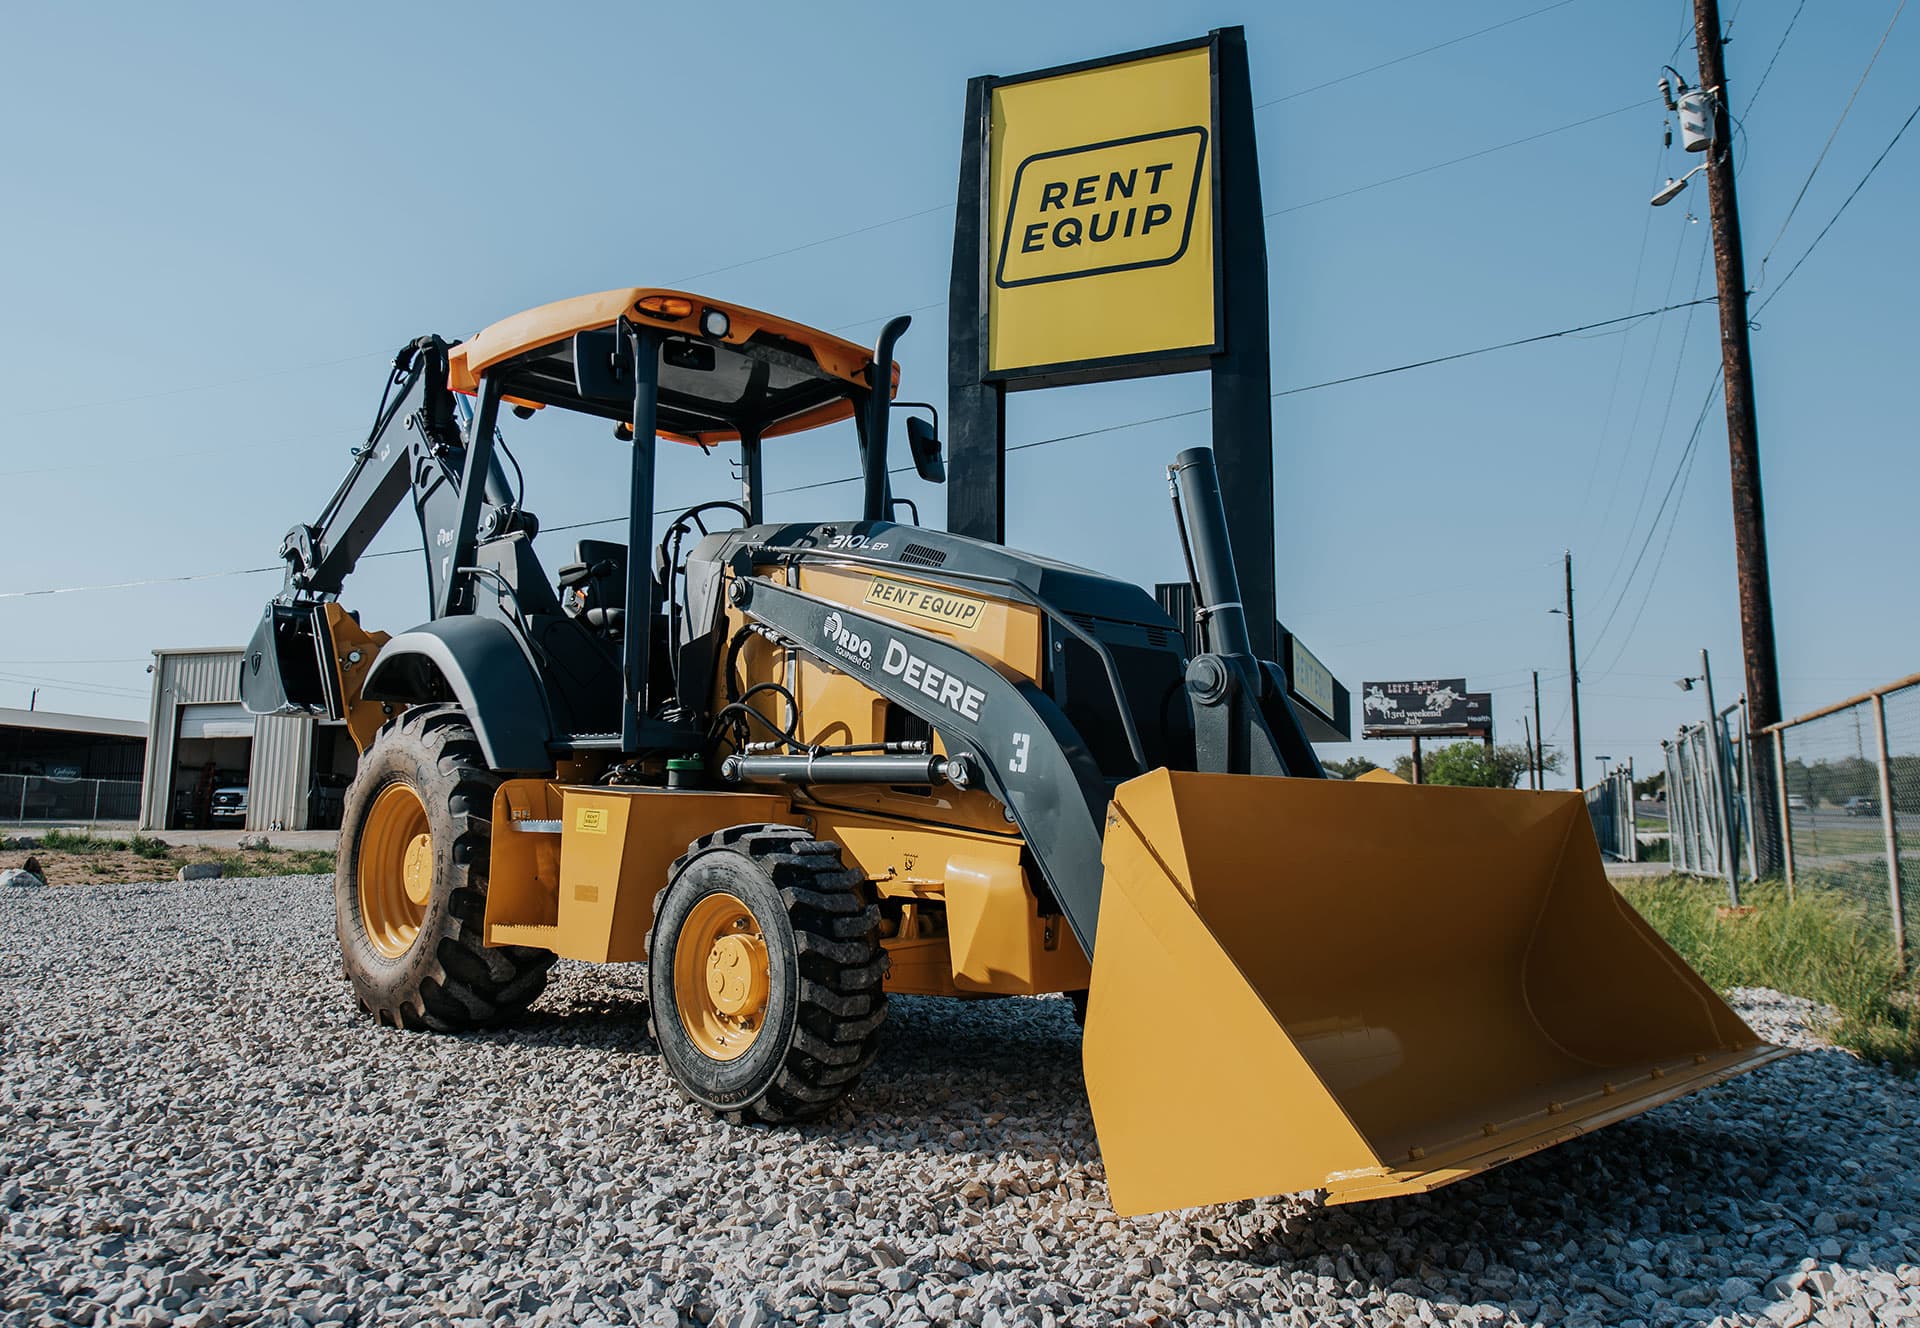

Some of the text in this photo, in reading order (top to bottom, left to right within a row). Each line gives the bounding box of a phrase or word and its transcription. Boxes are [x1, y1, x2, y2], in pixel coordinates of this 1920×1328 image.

[1039, 163, 1173, 213] RENT
[1021, 203, 1173, 255] EQUIP
[827, 534, 889, 551] 310L EP
[872, 582, 977, 620] RENT EQUIP
[882, 638, 986, 722] DEERE
[1388, 684, 1410, 693] LET'S
[1009, 732, 1030, 773] 3
